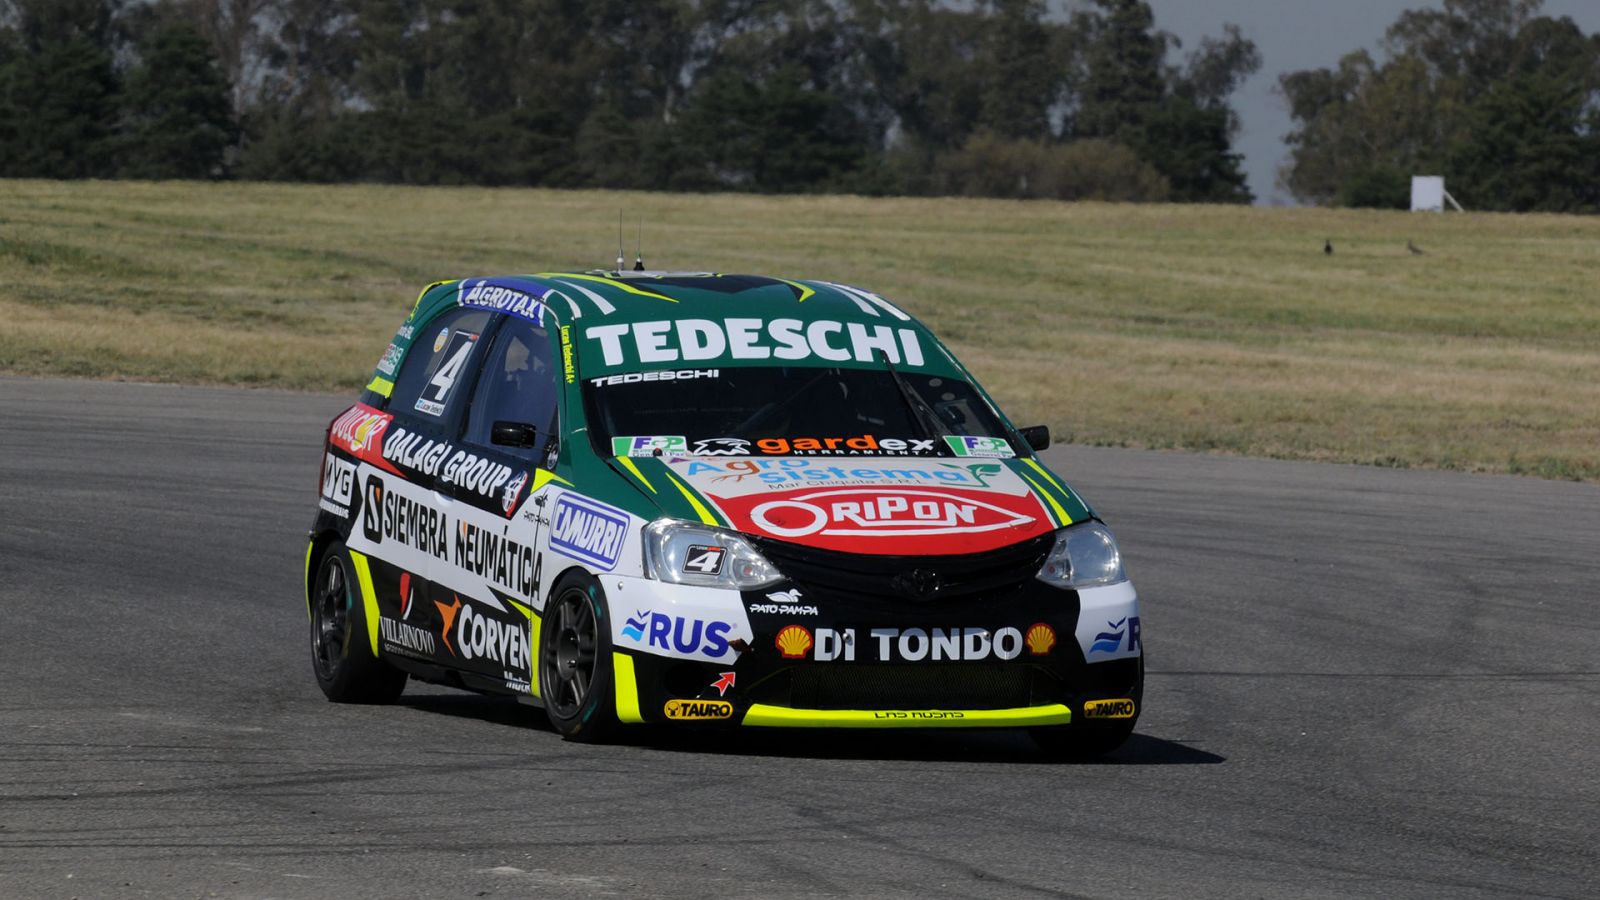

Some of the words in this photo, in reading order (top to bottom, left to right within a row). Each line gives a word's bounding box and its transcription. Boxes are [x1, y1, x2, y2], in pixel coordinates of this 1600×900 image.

[466, 280, 535, 318] AGROTAX
[585, 318, 925, 366] TEDESCHI
[431, 341, 473, 400] 4
[591, 369, 719, 387] TEDESCHI
[756, 434, 934, 454] gardex
[444, 450, 512, 498] GROUP
[687, 458, 809, 477] Agro
[758, 466, 966, 484] sistema
[768, 481, 800, 490] Mar
[806, 478, 875, 487] Chiquita
[552, 503, 624, 561] CAMURRI
[751, 497, 978, 537] ORIPON
[384, 490, 448, 562] SIEMBRA
[455, 518, 543, 602] NEUMÁTICA
[687, 551, 721, 571] 4
[379, 615, 436, 654] VILLARNOVO
[458, 604, 532, 677] CORVEN
[649, 612, 732, 658] RUS
[814, 627, 856, 662] DI
[870, 626, 1023, 661] TONDO
[681, 703, 731, 717] TAURO
[1095, 701, 1133, 716] TAURO
